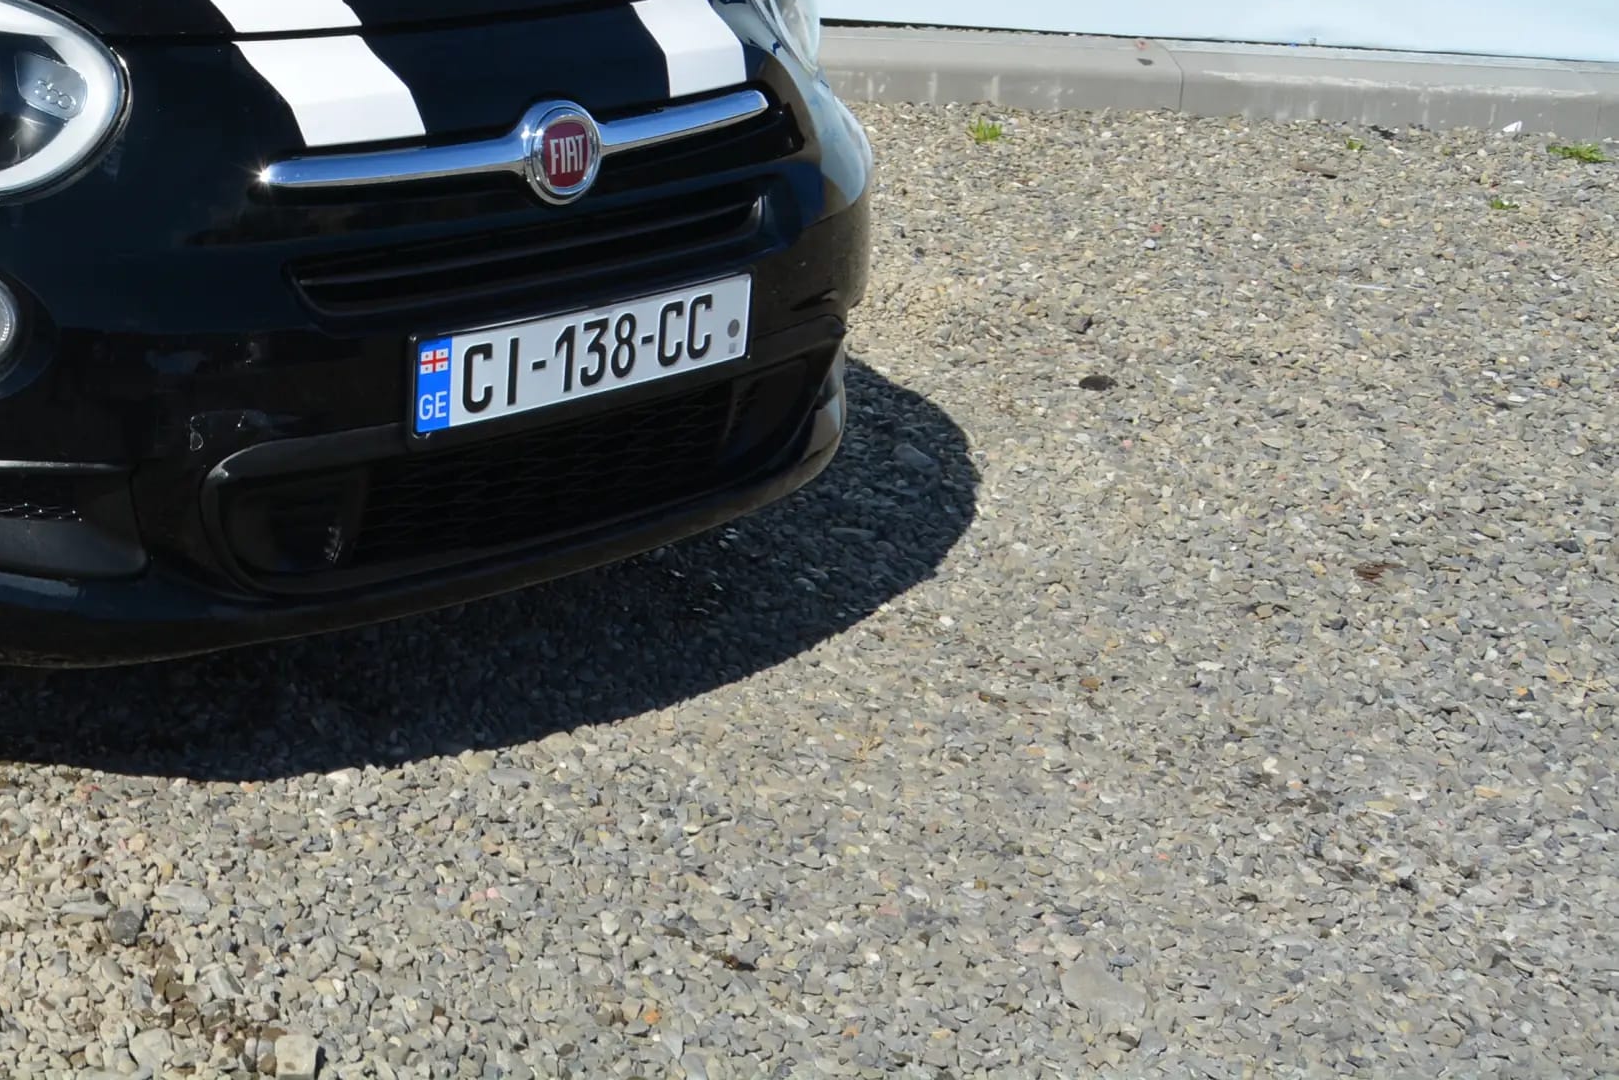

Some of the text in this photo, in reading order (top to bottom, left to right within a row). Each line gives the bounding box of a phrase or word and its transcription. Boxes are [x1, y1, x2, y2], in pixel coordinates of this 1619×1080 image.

[550, 134, 584, 175] FIAT
[462, 293, 713, 414] CI-138-CC
[418, 390, 448, 420] GE
